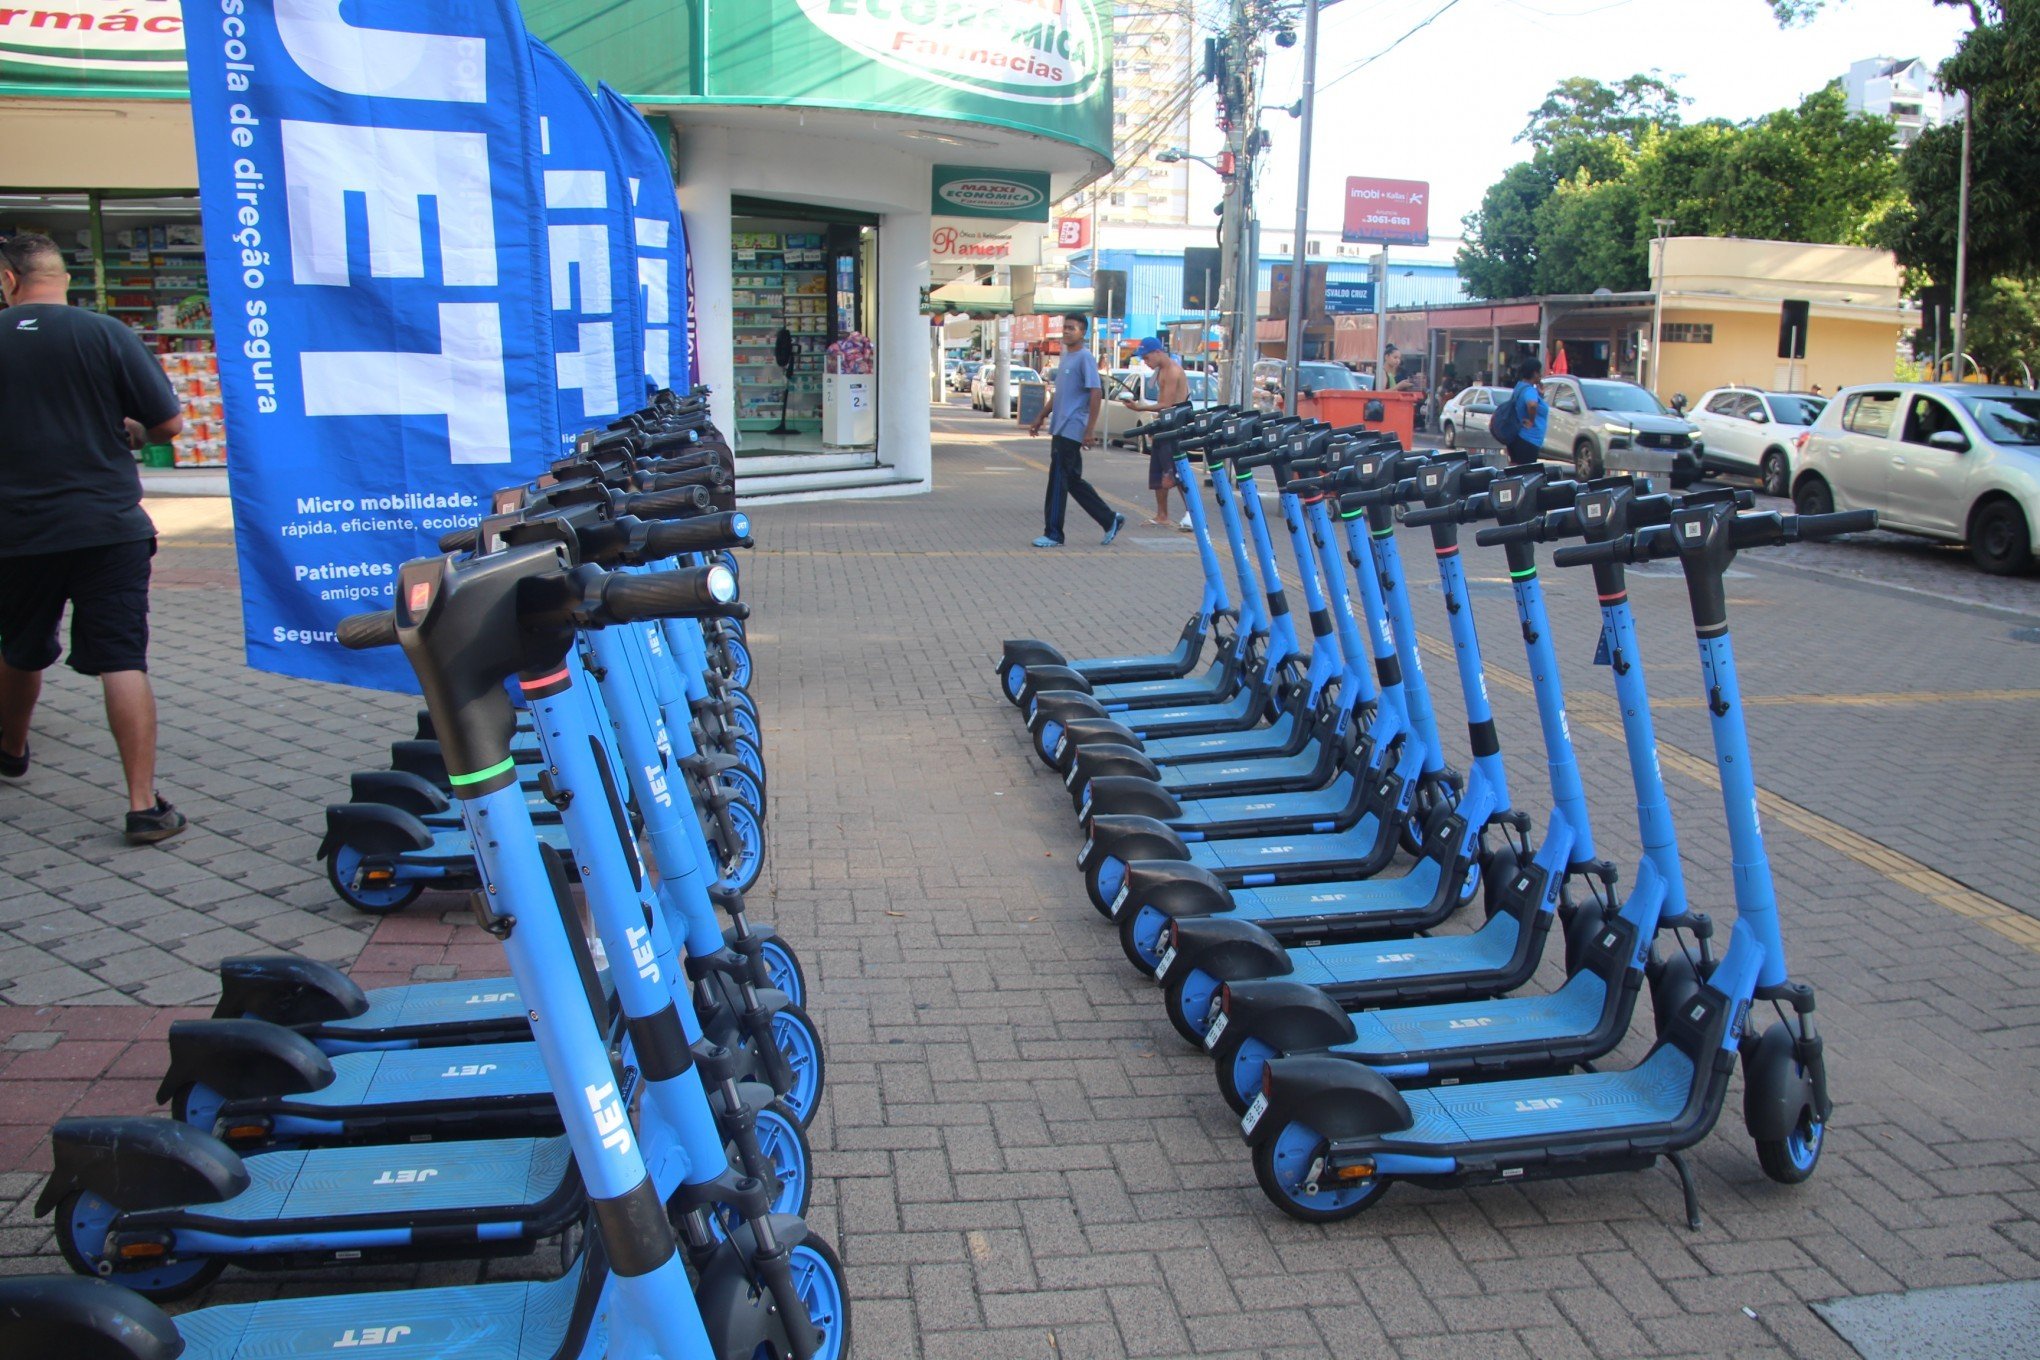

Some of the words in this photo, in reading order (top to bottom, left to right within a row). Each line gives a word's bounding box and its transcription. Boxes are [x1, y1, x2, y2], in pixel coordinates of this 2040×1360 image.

[229, 104, 260, 148] de
[232, 158, 271, 289] direção
[243, 300, 278, 414] segura
[297, 497, 355, 515] Micro
[361, 492, 479, 511] mobilidade:
[281, 517, 338, 539] rápida,
[341, 514, 418, 534] eficiente,
[295, 562, 394, 582] Patinetes
[321, 583, 379, 601] amigos
[644, 764, 672, 809] JET
[625, 925, 661, 984] JET
[1376, 952, 1416, 964] JET
[465, 992, 516, 1005] JET
[1449, 1017, 1492, 1029] JET
[441, 1063, 498, 1078] JET
[1515, 1097, 1563, 1113] JET
[585, 1080, 632, 1156] JET
[373, 1168, 439, 1185] JET
[333, 1325, 412, 1348] JET
